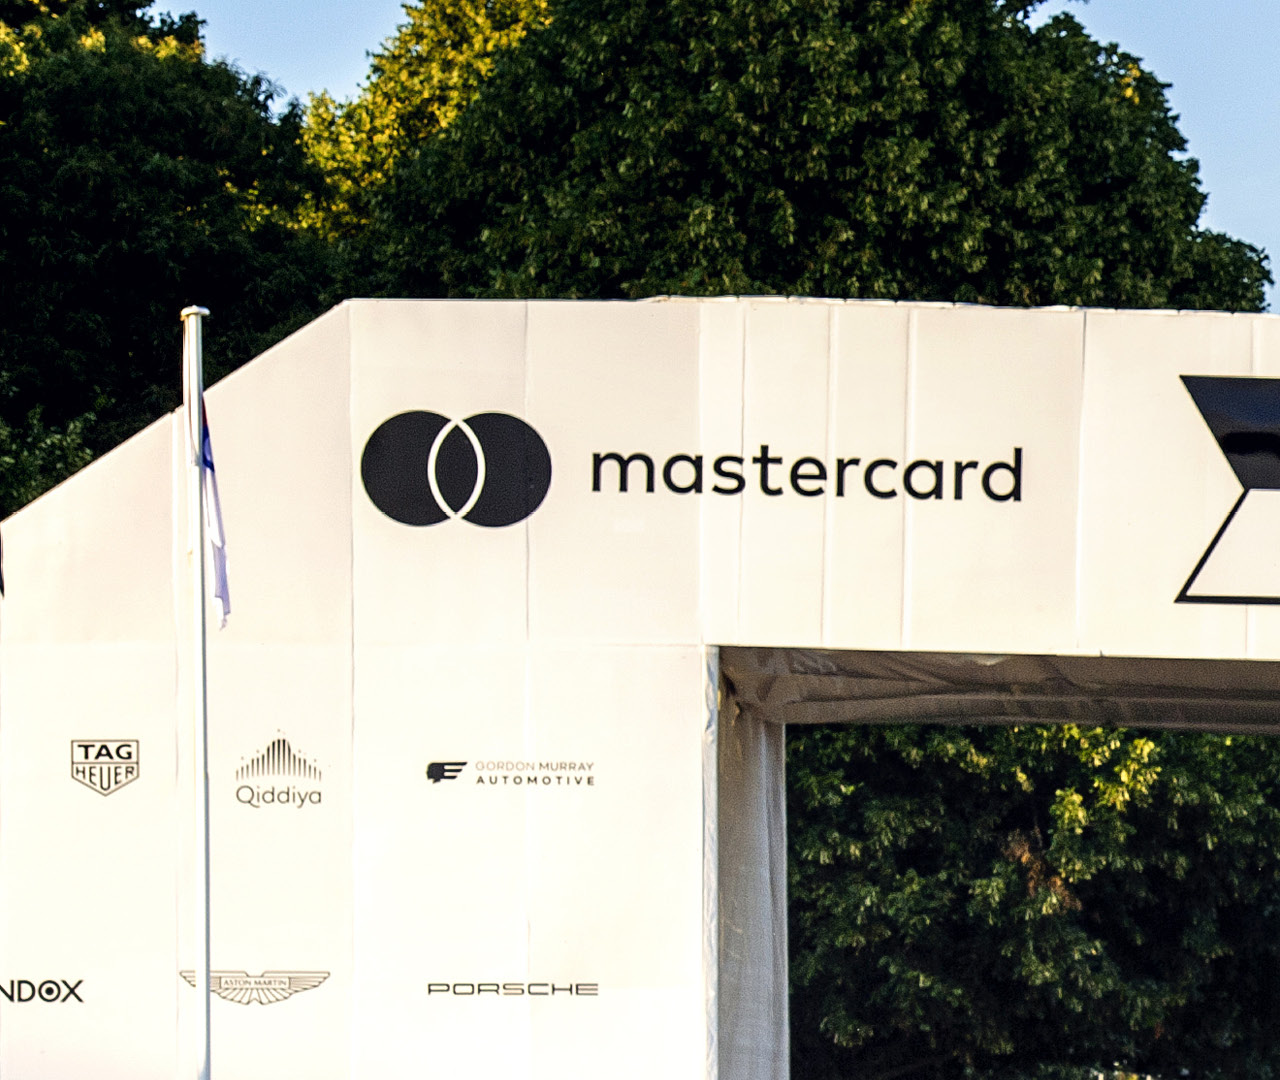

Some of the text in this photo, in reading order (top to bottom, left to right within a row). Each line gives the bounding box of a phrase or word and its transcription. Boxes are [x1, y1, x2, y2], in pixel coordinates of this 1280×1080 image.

[591, 444, 1023, 502] mastercard
[77, 743, 132, 760] TAG
[475, 760, 594, 772] GORDON MURRAY
[75, 765, 135, 791] HEUER
[476, 775, 594, 786] AUTOMOTIVE
[235, 784, 323, 808] Qiddiya
[223, 978, 288, 987] ASTON MARTIN
[427, 983, 598, 997] PORSCHE
